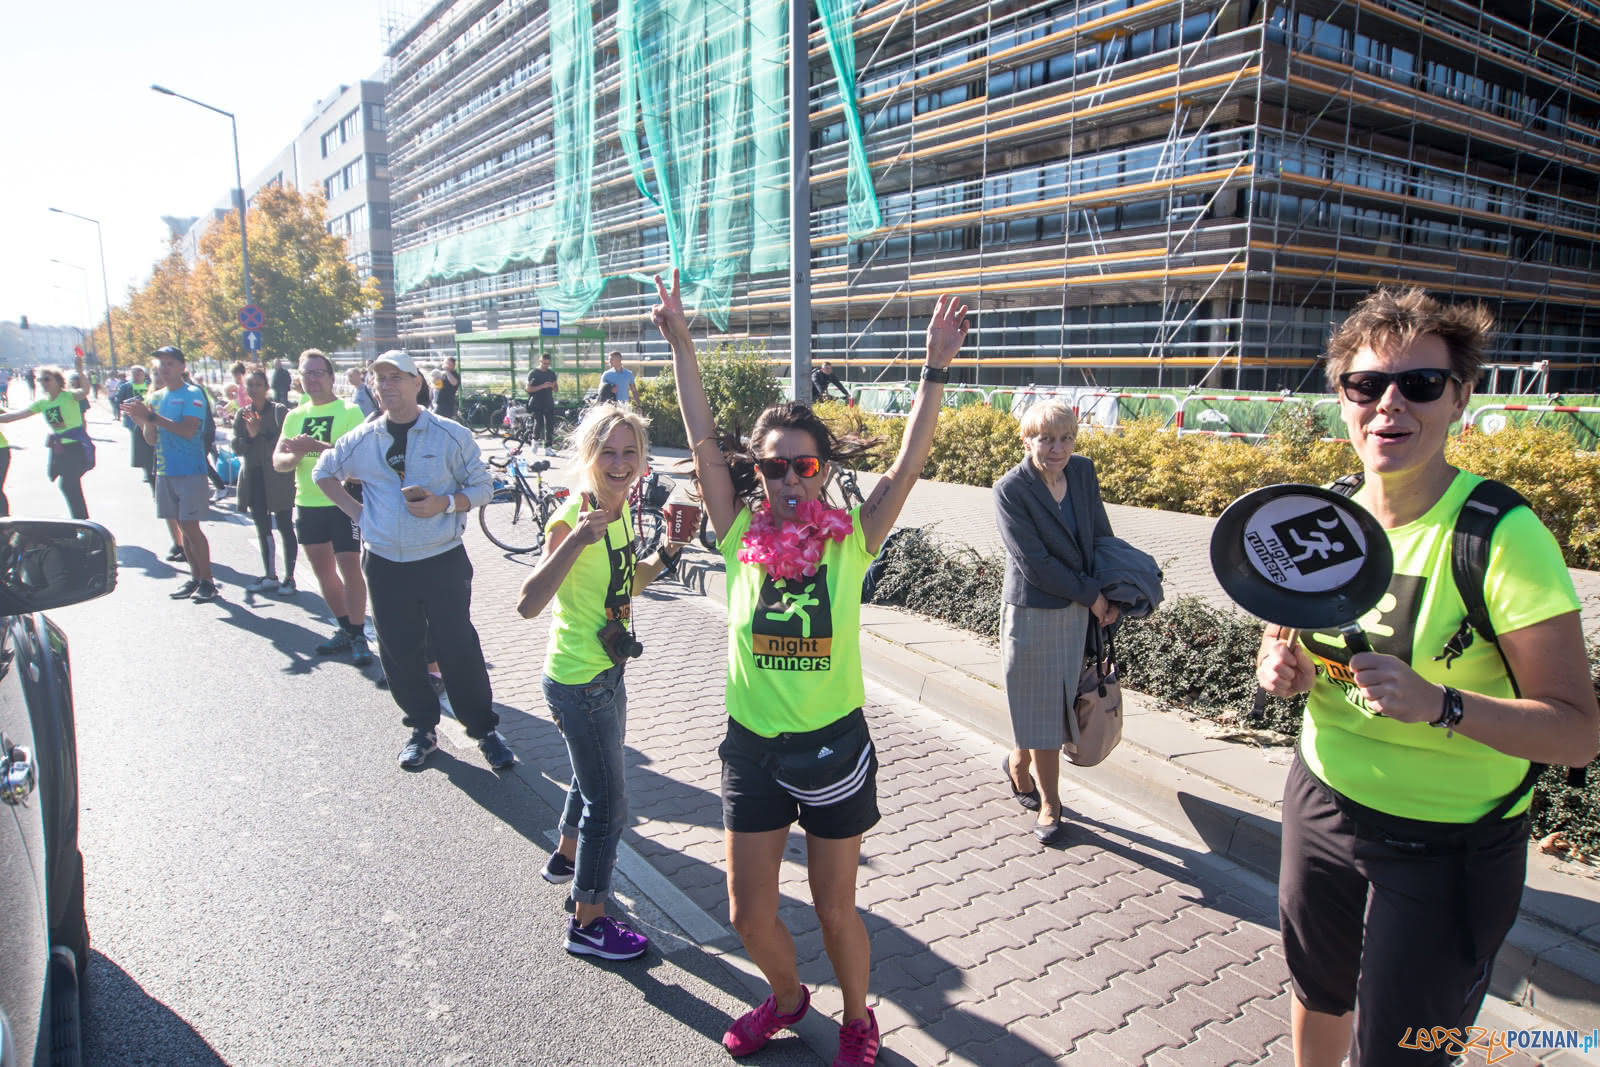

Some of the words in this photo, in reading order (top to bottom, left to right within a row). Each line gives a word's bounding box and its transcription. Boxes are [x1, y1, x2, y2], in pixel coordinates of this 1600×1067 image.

[674, 510, 683, 534] COSTA
[1247, 532, 1288, 583] runners
[1266, 538, 1295, 572] night
[768, 637, 819, 656] night
[753, 654, 831, 671] runners
